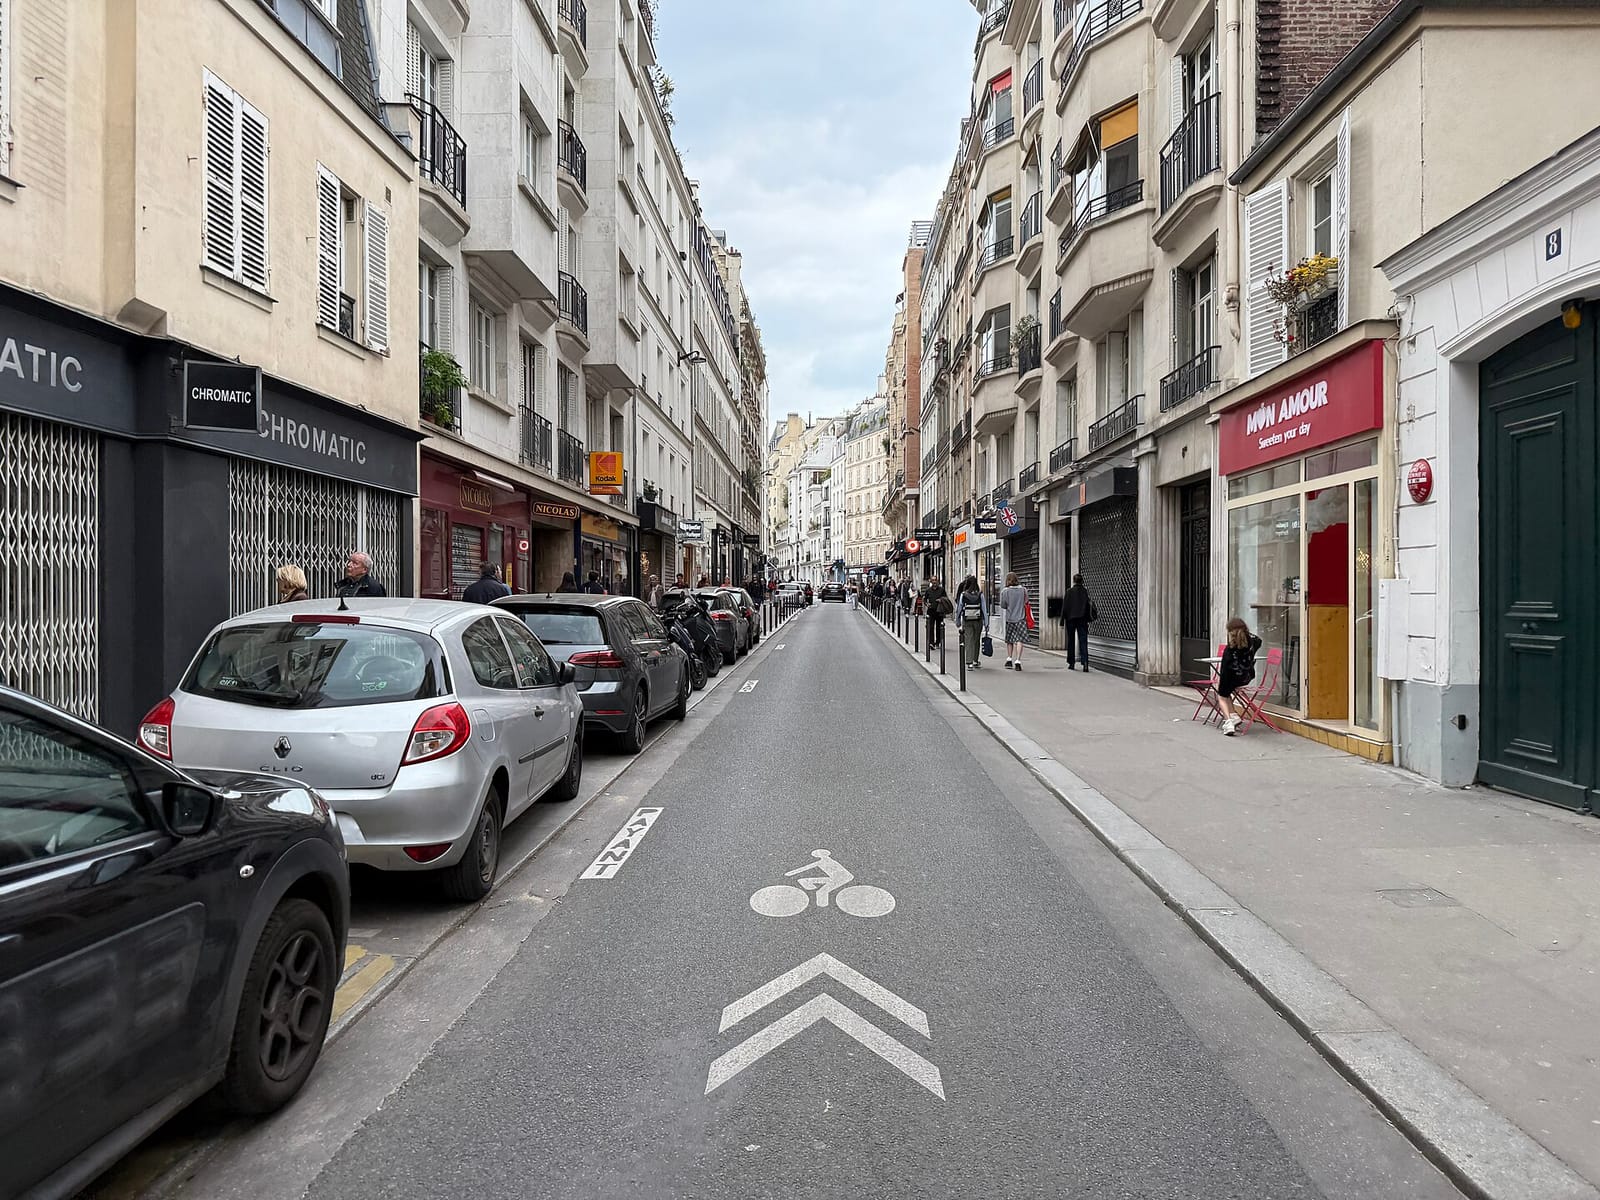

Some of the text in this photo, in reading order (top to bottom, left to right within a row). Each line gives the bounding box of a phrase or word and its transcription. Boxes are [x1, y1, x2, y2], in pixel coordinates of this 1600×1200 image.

[1549, 233, 1557, 255] 8
[0, 337, 82, 392] ATIC
[191, 387, 252, 404] CHROMATIC
[1278, 381, 1328, 424] AMOUR
[259, 409, 366, 464] CHROMATIC
[1258, 422, 1311, 449] Sweeten your day
[461, 484, 491, 507] NICOLAS
[535, 504, 575, 516] NICOLAS
[259, 764, 304, 773] CLIO
